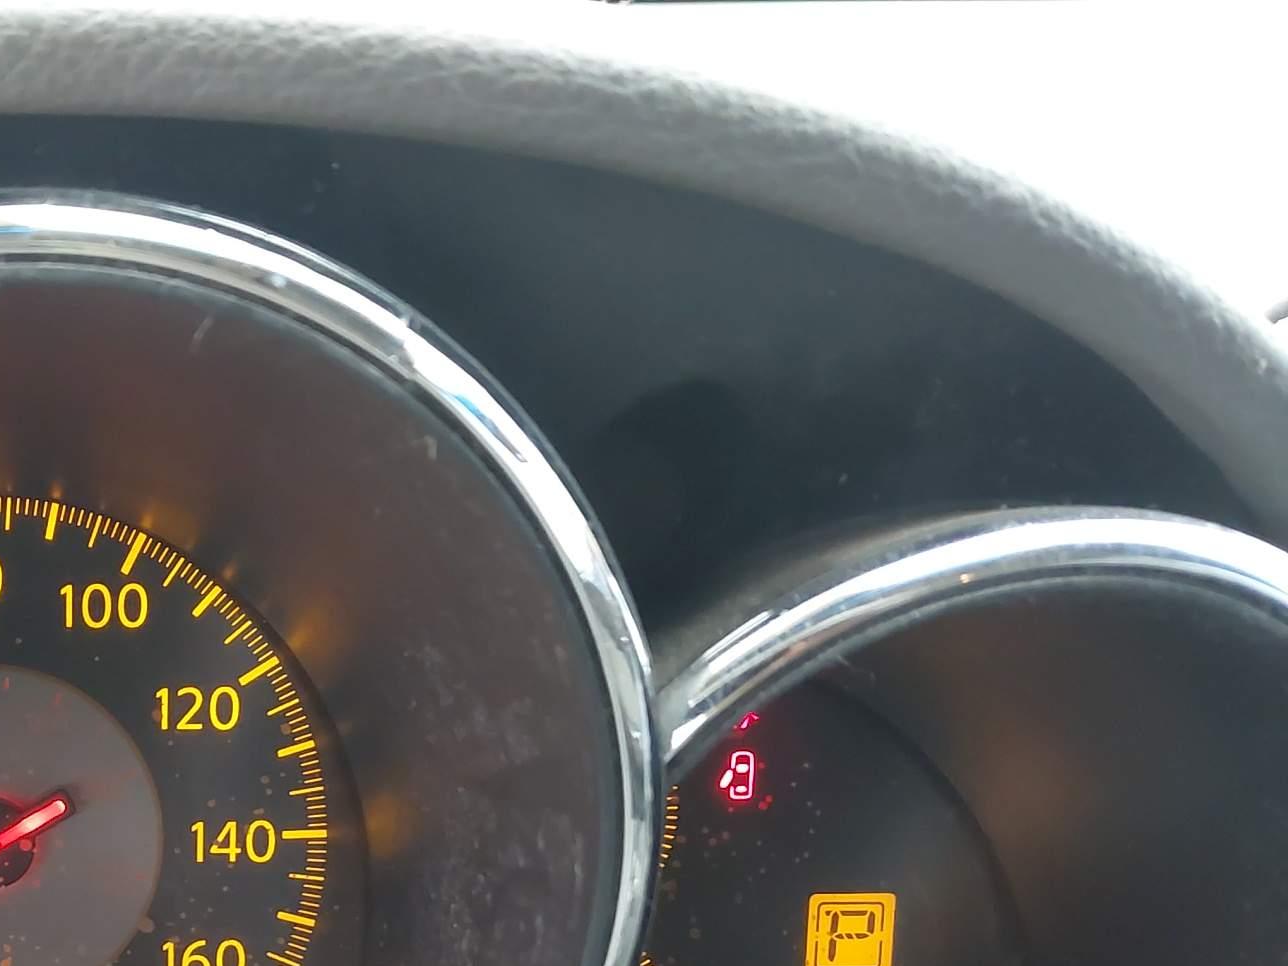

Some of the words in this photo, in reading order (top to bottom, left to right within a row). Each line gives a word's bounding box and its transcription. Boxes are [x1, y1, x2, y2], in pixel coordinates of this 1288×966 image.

[59, 582, 149, 629] 100
[154, 686, 241, 732] 120
[190, 819, 278, 864] 140
[824, 910, 876, 963] P
